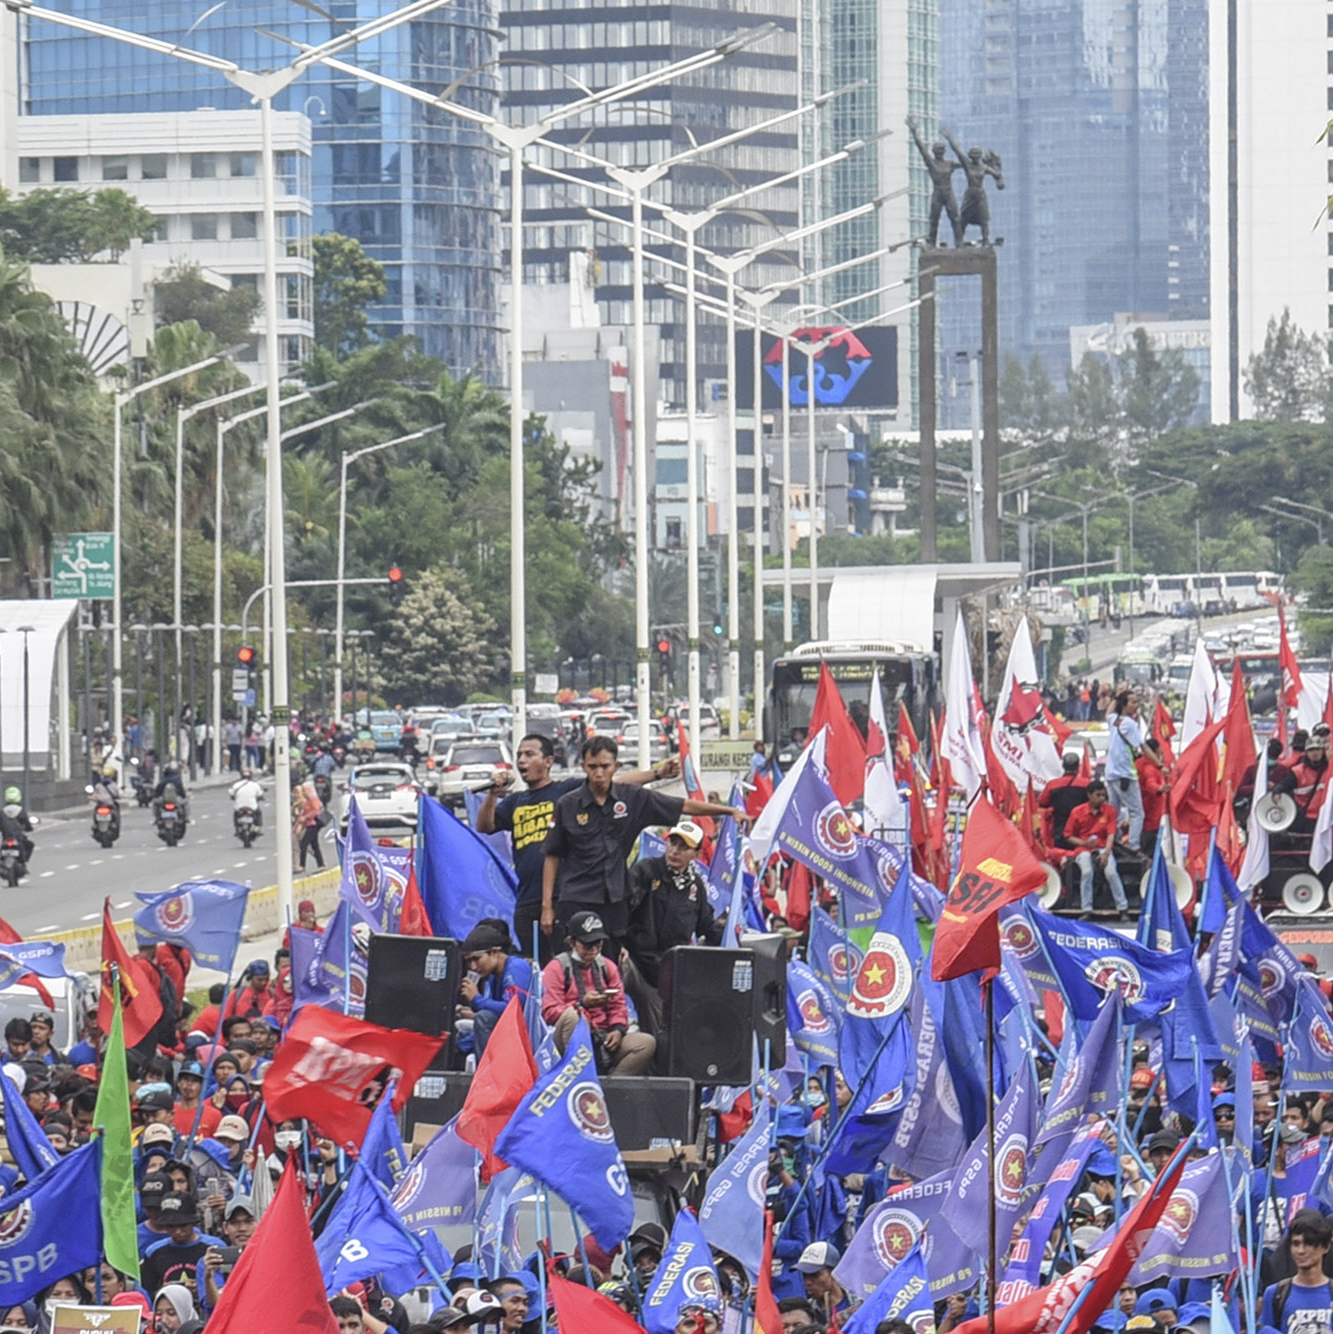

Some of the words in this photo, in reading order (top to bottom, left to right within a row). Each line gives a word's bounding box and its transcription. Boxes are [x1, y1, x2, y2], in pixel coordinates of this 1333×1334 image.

[809, 852, 834, 872] FOODS
[649, 1241, 695, 1307] FEDERASI
[885, 1275, 927, 1321] DERASI
